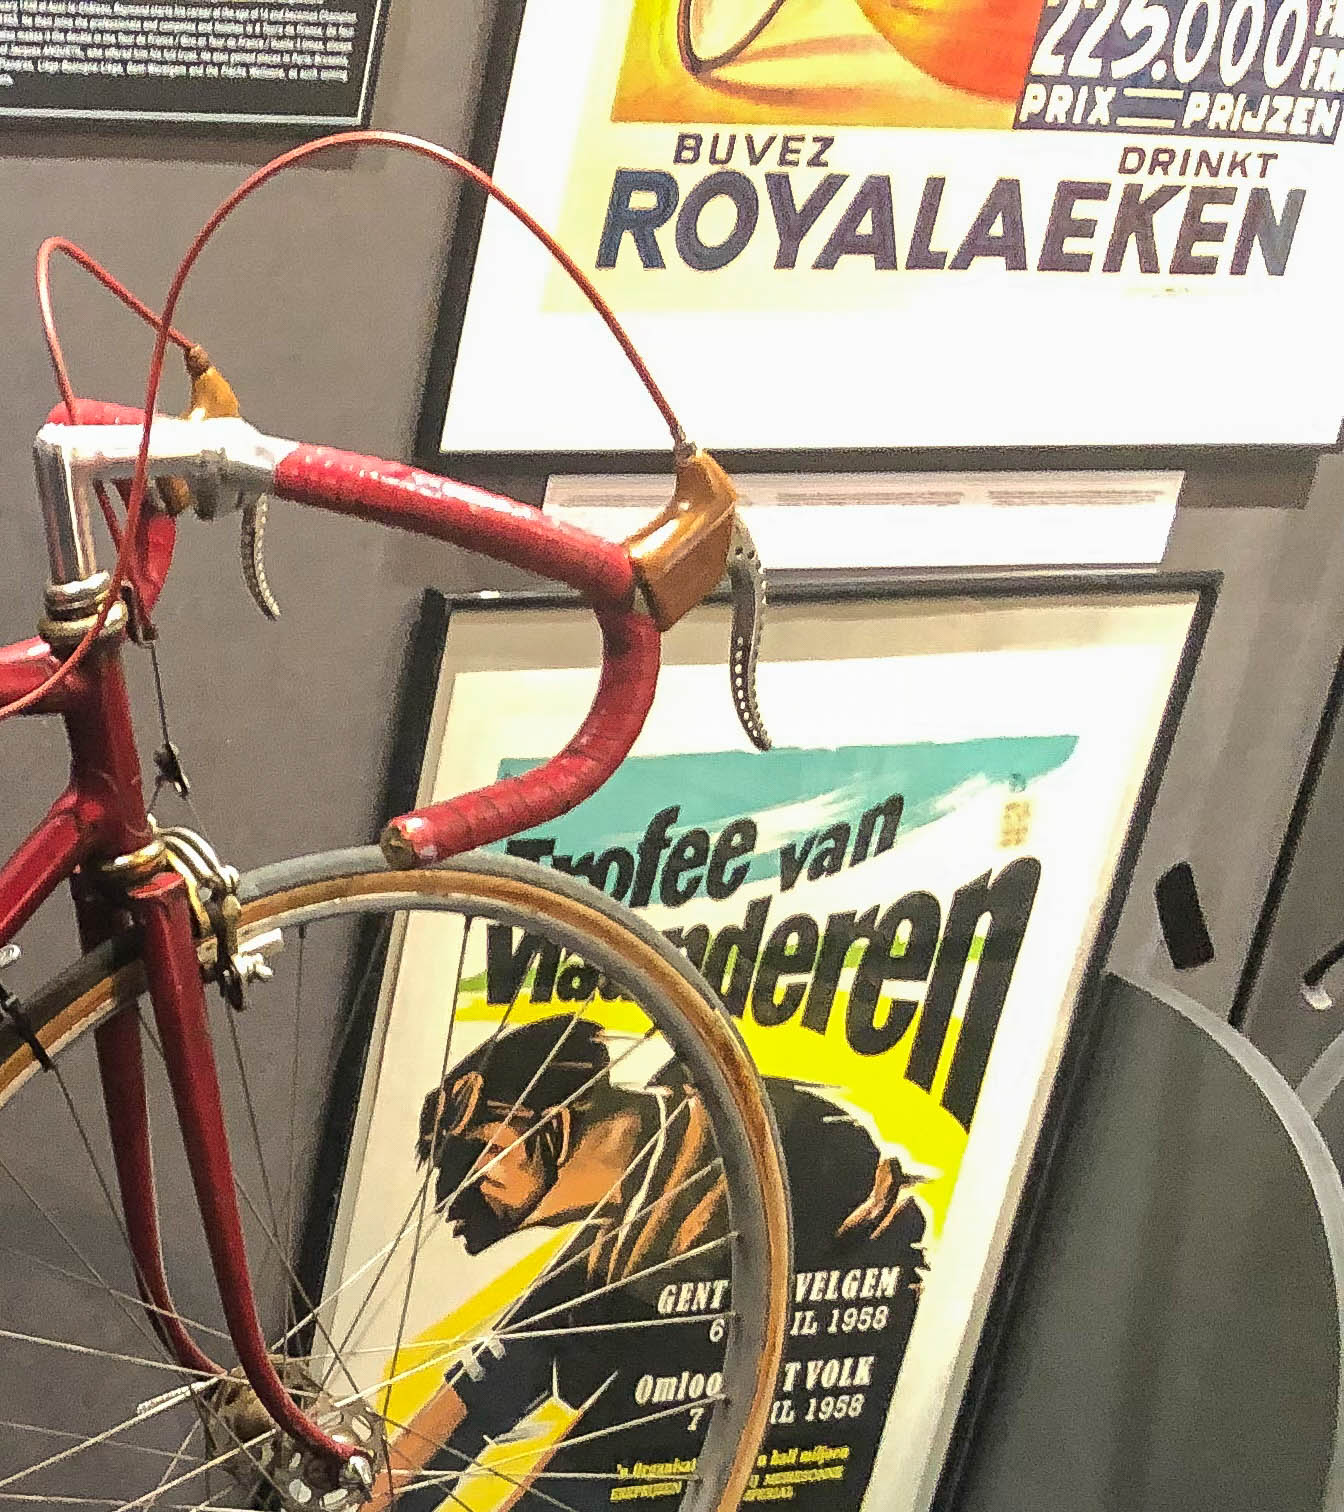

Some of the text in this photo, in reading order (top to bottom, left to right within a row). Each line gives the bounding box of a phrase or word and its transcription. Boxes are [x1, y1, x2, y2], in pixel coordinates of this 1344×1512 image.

[1018, 83, 1342, 138] PRIX PRIJZEN
[673, 132, 1279, 178] BUVEZ DRINKT
[594, 167, 1308, 277] ROYALAEKEN
[778, 792, 906, 892] van
[486, 855, 1043, 1133] Vlanderen
[708, 1318, 725, 1343] 6
[826, 1305, 890, 1335] 1958
[634, 1371, 724, 1407] Omloo
[805, 1356, 875, 1391] VOLK
[687, 1407, 705, 1432] 7
[805, 1393, 866, 1422] 1958
